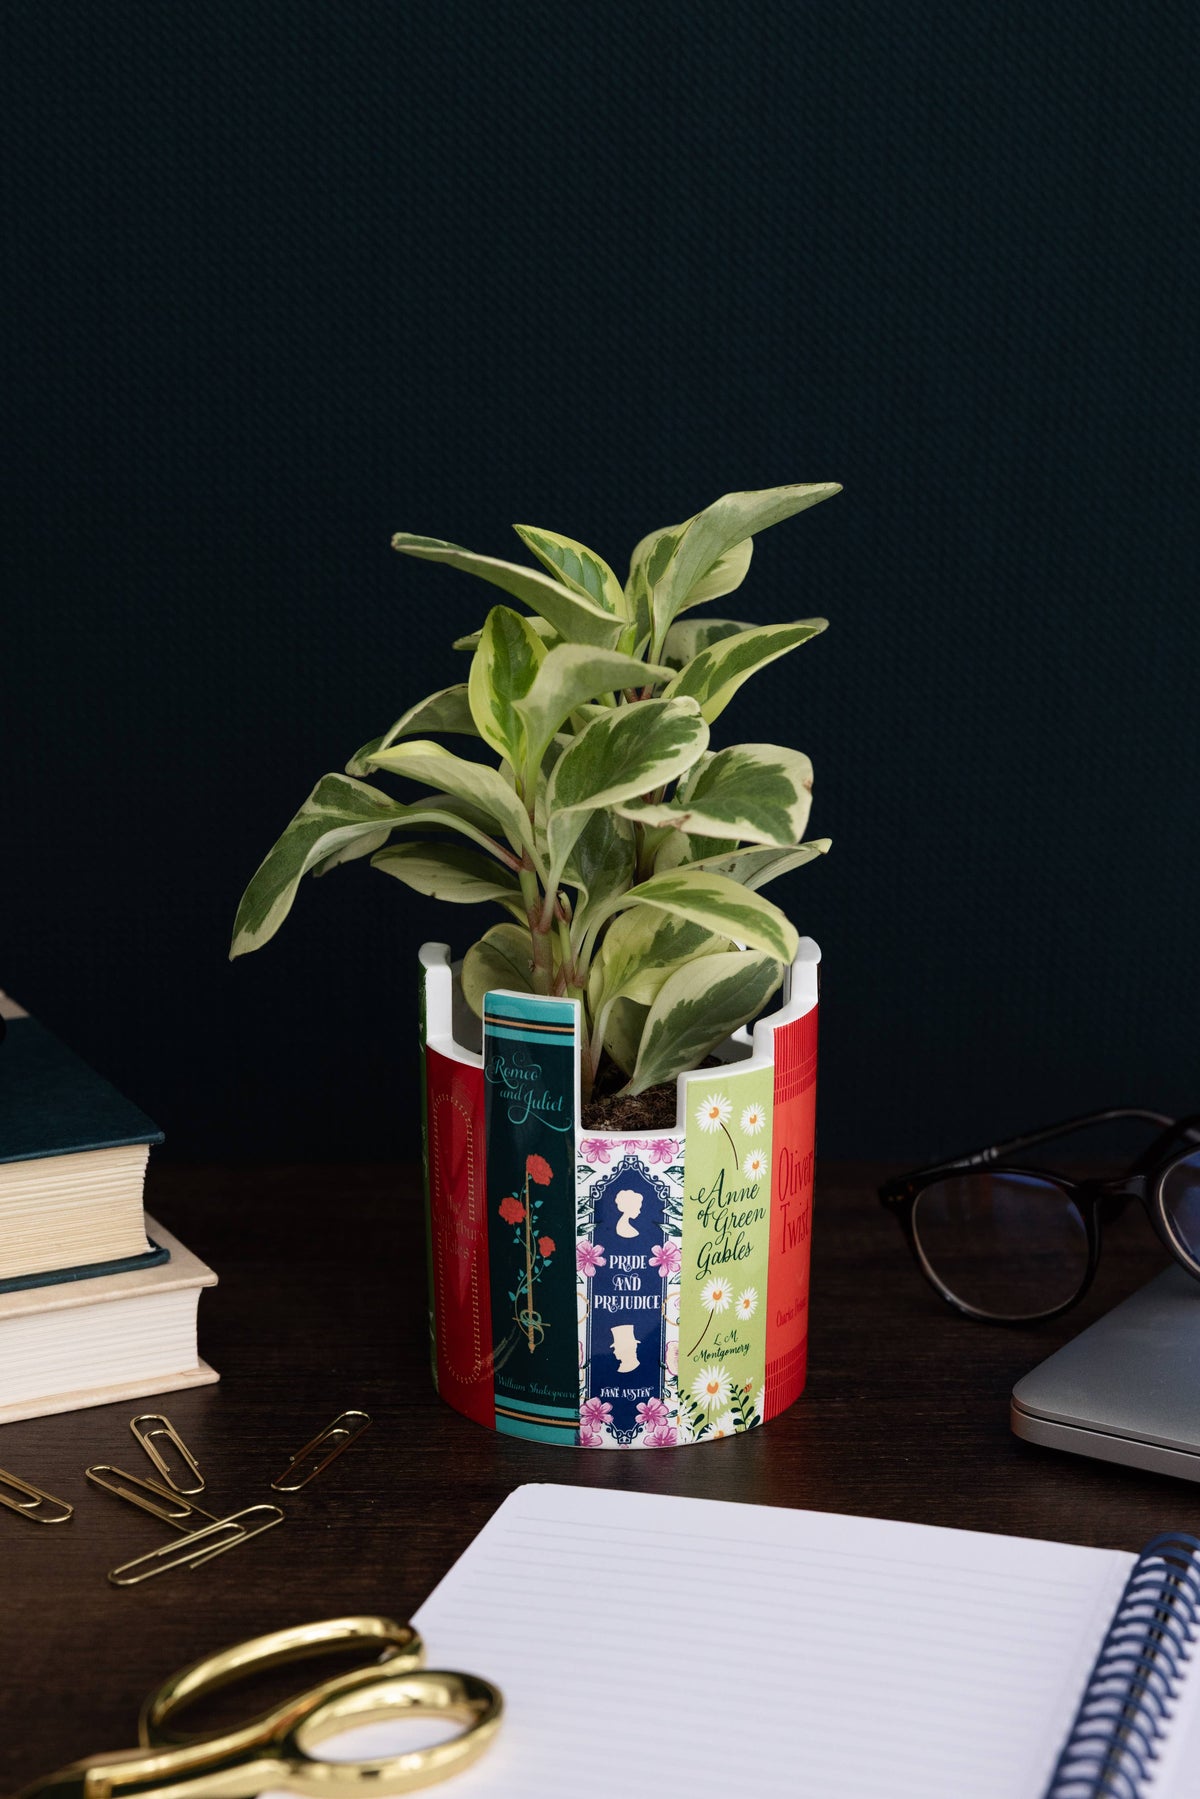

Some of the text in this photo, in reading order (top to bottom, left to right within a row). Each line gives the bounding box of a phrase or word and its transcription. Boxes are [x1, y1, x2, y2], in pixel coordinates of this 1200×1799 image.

[485, 1052, 542, 1089] Romeo
[500, 1082, 572, 1132] and Juliet
[690, 1168, 760, 1208] Anne
[778, 1146, 813, 1202] Oliver
[697, 1198, 766, 1245] of Green
[780, 1198, 809, 1254] Twist
[609, 1255, 648, 1272] PRIDE
[695, 1231, 754, 1281] Gables
[612, 1273, 642, 1291] AND
[594, 1295, 661, 1313] PREJUDICE
[693, 1342, 752, 1363] Montgomery
[600, 1386, 654, 1401] JANE AUSTEN
